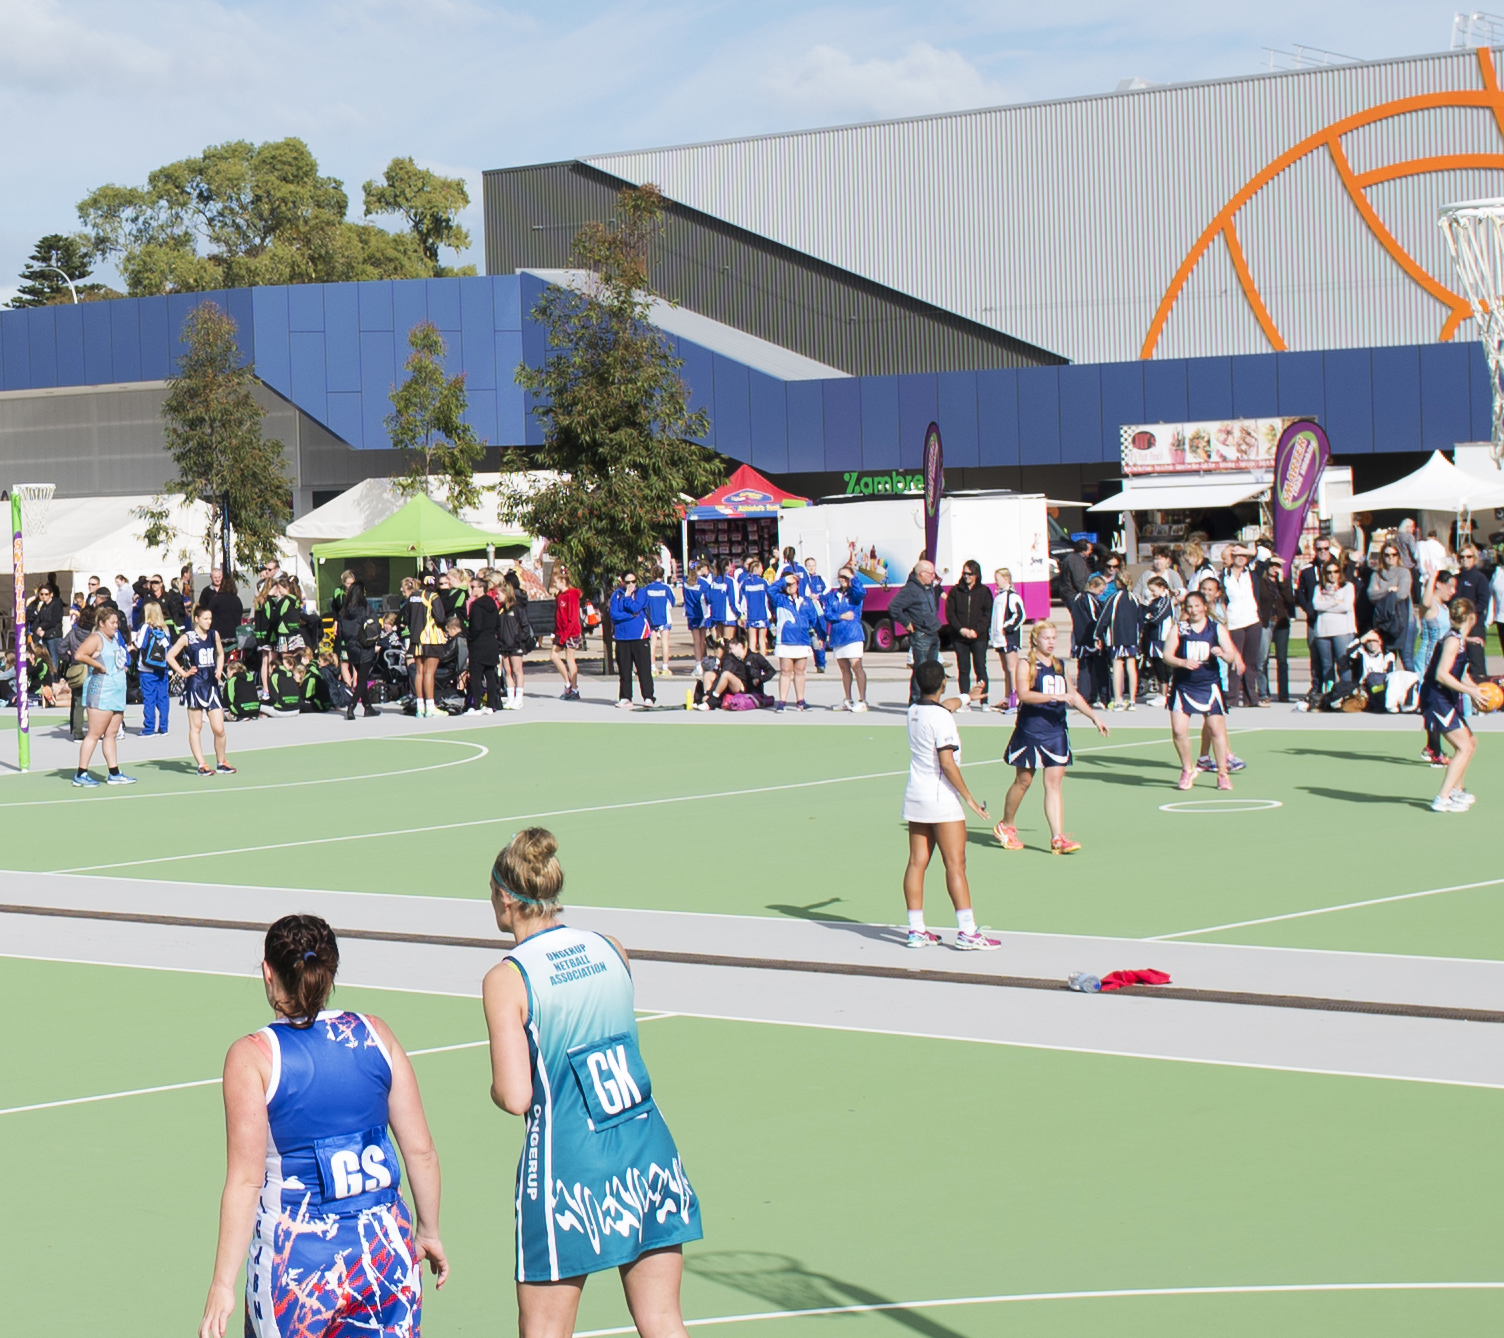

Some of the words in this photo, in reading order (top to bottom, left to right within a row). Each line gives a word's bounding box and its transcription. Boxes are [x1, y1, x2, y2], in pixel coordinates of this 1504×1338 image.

[844, 471, 926, 494] Zambre
[14, 537, 26, 624] SMARTER
[198, 647, 215, 665] GK
[545, 943, 586, 961] ONGERUP
[553, 954, 591, 972] NETBALL
[549, 961, 608, 986] ASSOCIATION
[586, 1044, 642, 1115] GK
[526, 1104, 542, 1201] ONGERUP
[330, 1144, 392, 1199] GS
